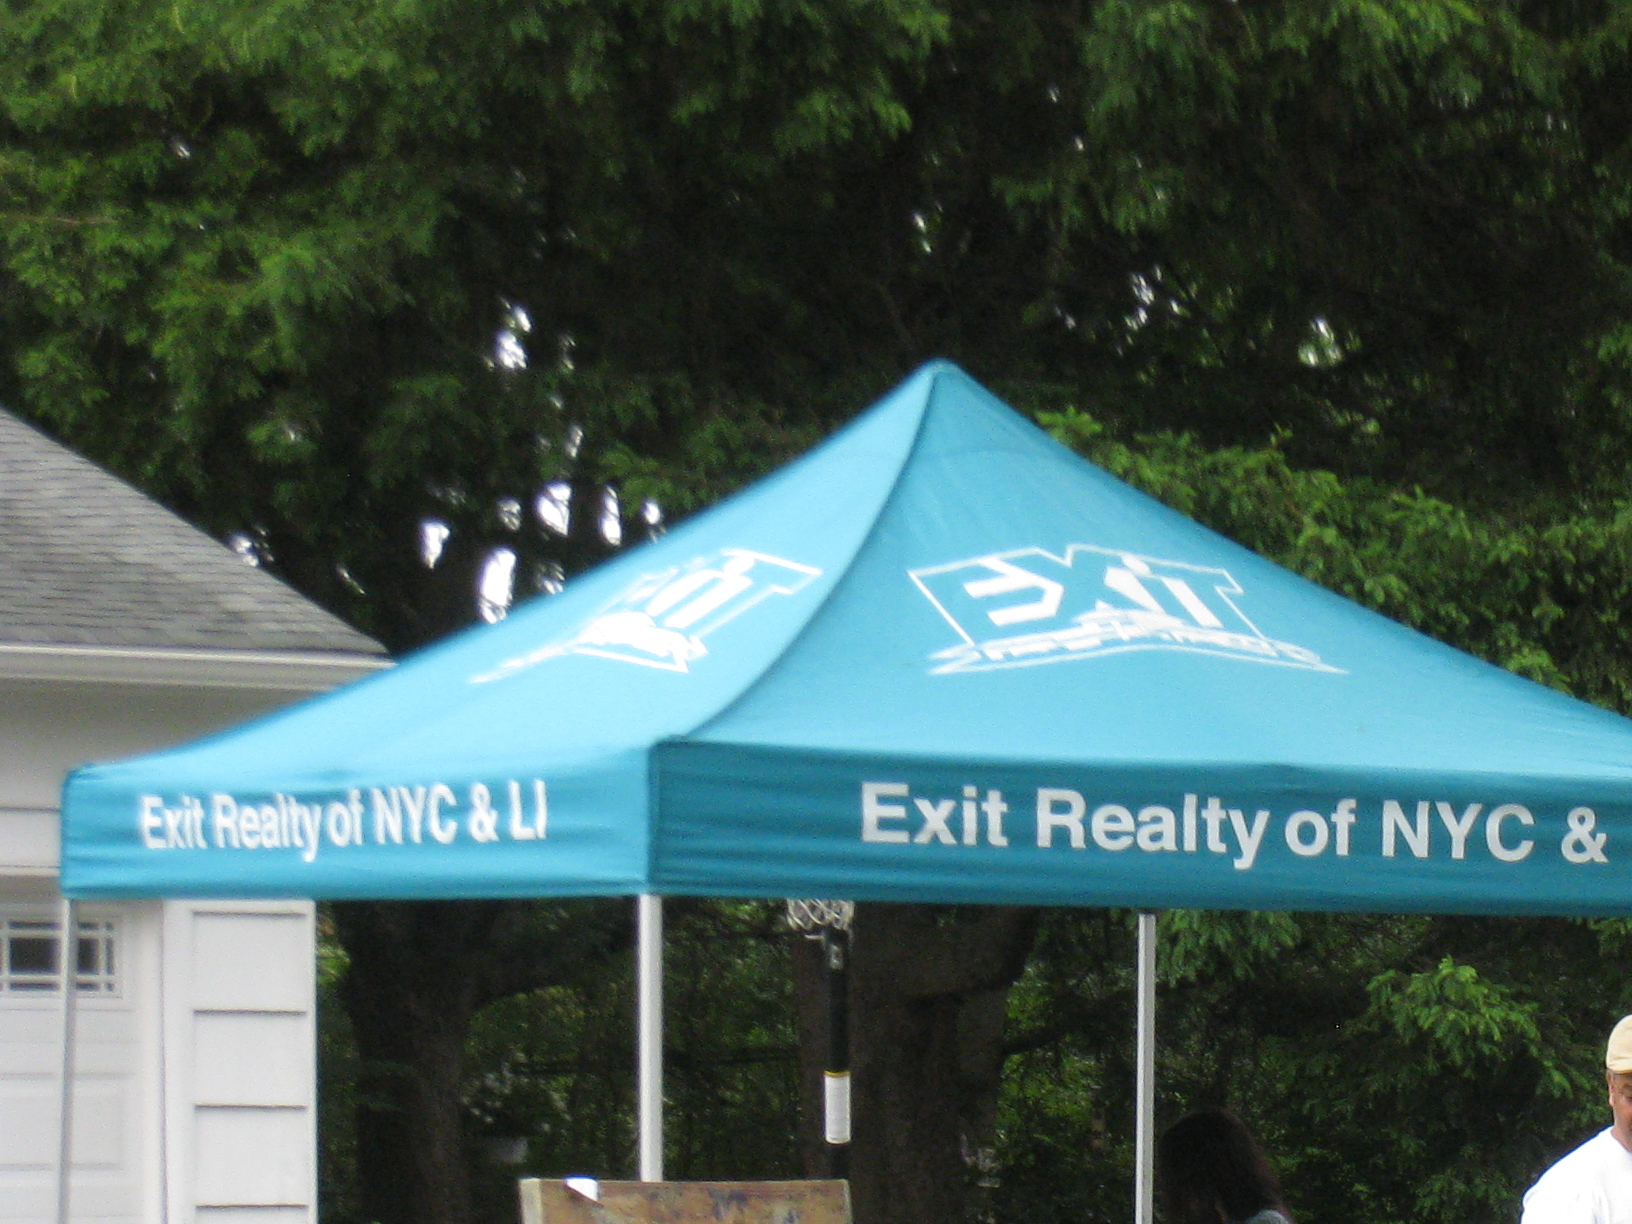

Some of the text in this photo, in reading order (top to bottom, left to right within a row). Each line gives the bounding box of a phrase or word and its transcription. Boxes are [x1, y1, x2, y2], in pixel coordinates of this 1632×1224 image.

[906, 544, 1272, 648] EXIT
[139, 780, 548, 863] Exit Realty of NYC & LI
[861, 782, 1009, 848] Exit
[1035, 787, 1271, 871] Realty
[1284, 798, 1357, 857] of
[1381, 800, 1535, 863] NYC
[1560, 806, 1609, 865] &
